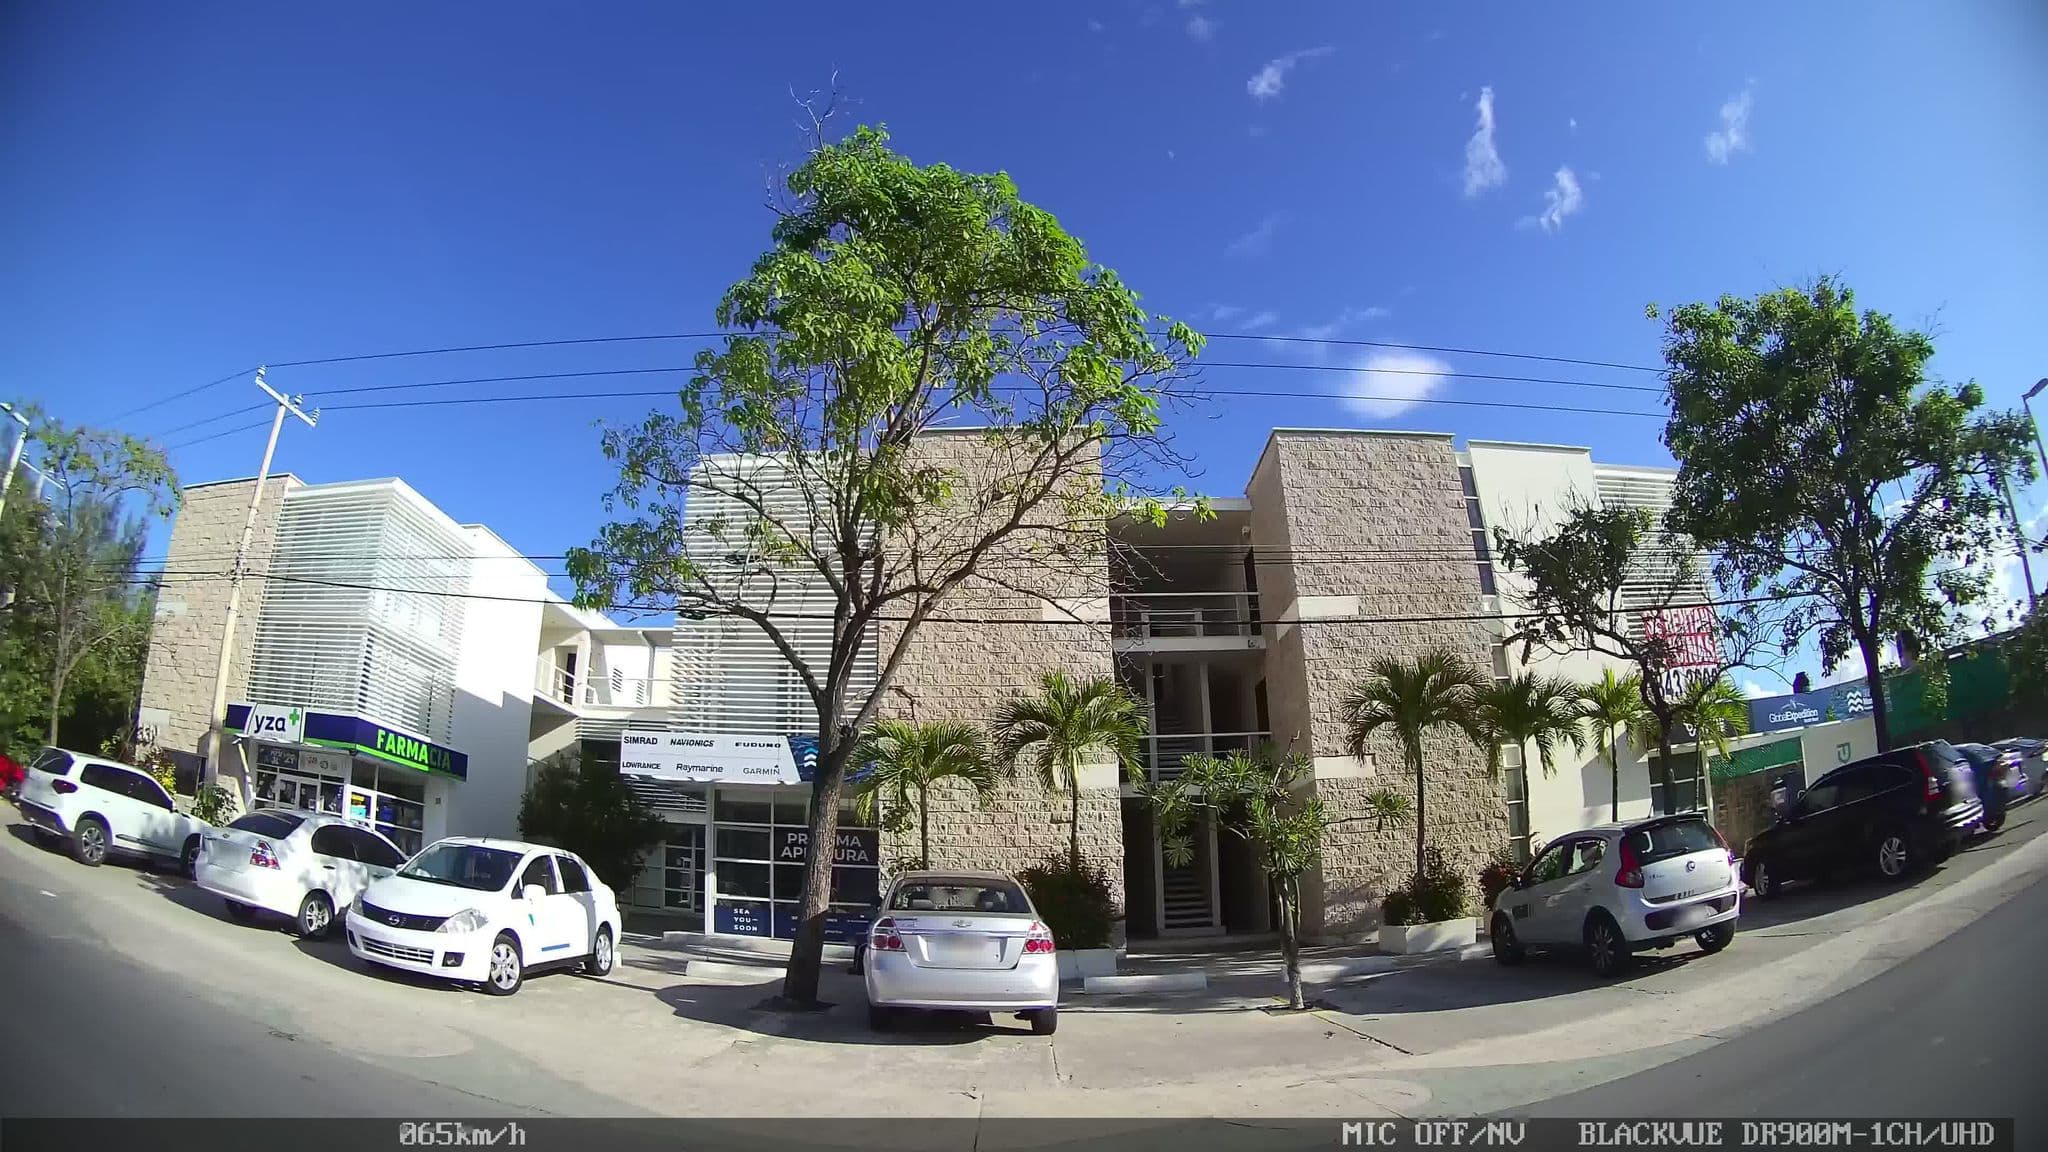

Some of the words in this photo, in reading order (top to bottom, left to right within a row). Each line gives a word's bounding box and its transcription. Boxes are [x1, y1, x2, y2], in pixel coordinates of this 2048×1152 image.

[254, 714, 286, 734] yza
[623, 736, 658, 745] SIMRAD
[670, 738, 715, 748] NAVIONICS
[376, 728, 451, 772] FARMACIA
[622, 761, 661, 770] LOWRANCE
[676, 763, 724, 773] Raymarine
[743, 766, 780, 775] GARMIN
[787, 832, 861, 847] PRMA
[781, 846, 869, 862] APURA
[733, 924, 758, 932] SOON
